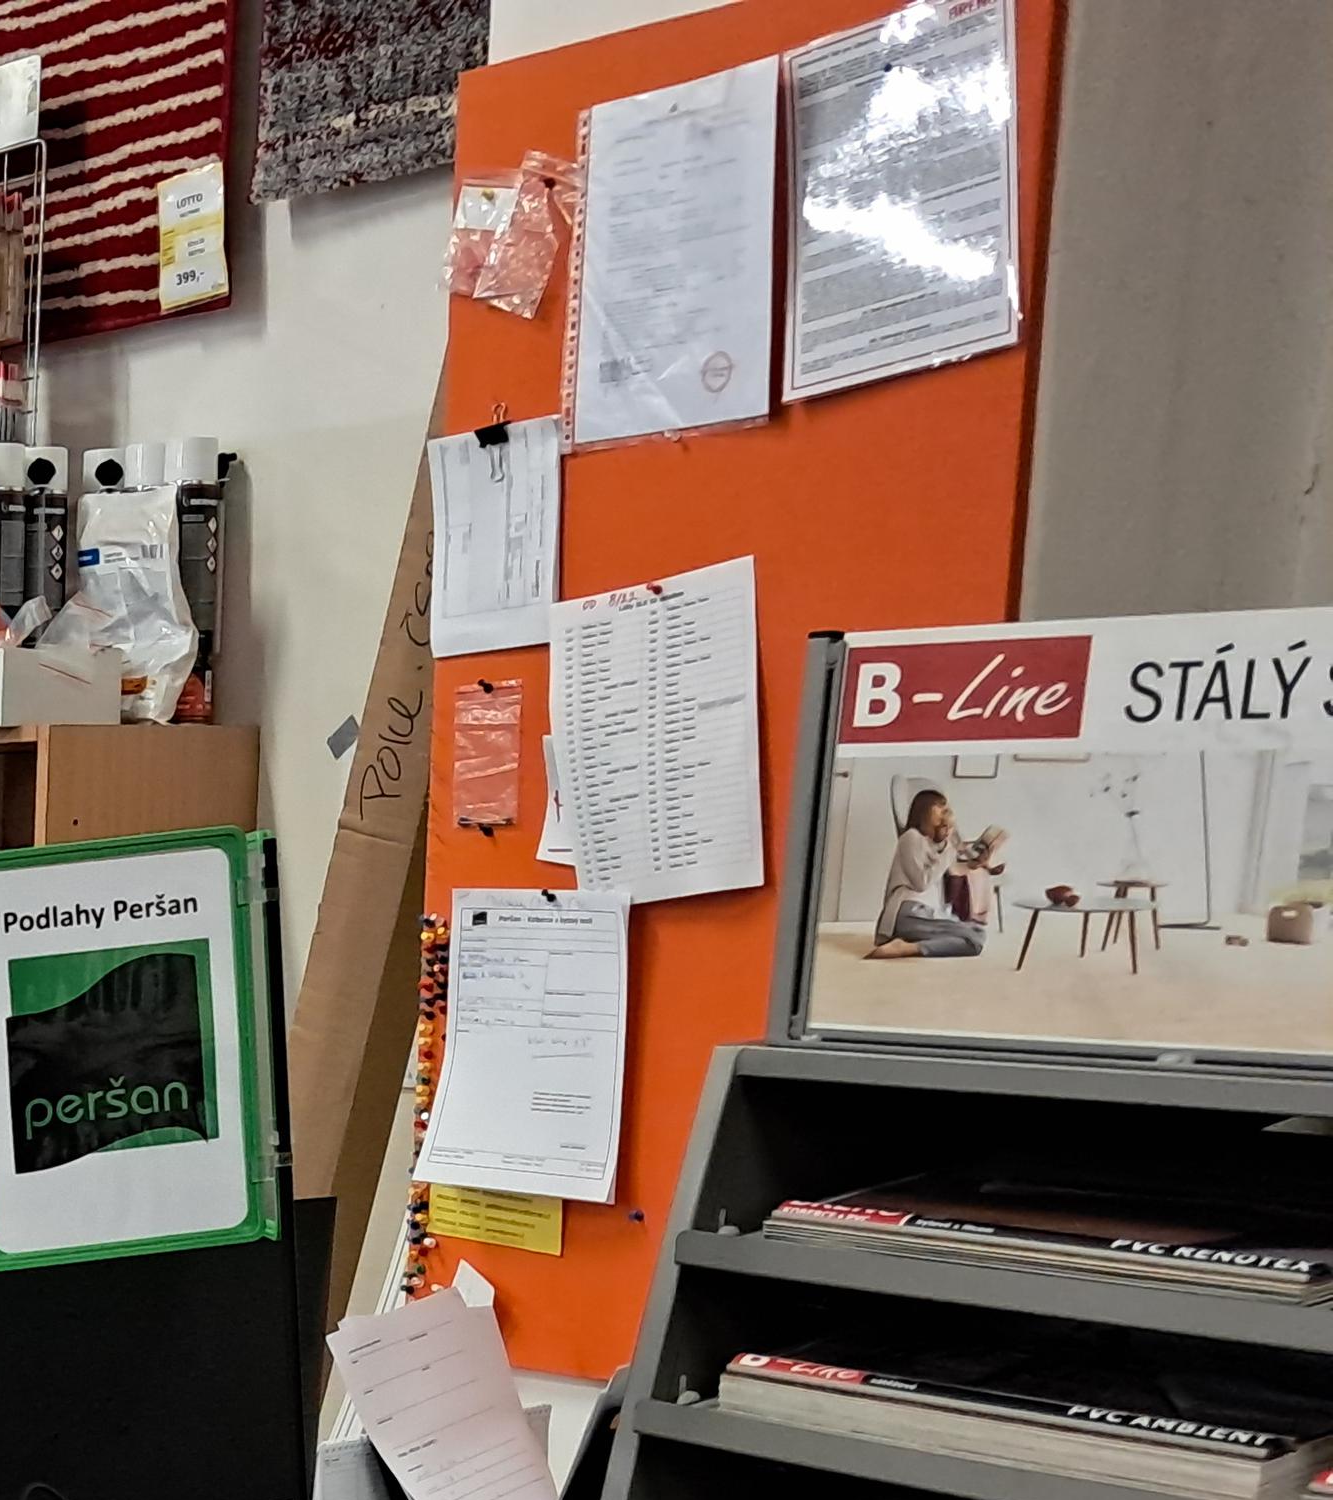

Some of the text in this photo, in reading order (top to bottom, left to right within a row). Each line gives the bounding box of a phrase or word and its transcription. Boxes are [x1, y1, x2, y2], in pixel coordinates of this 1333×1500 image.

[176, 193, 203, 209] LOTTO
[175, 269, 206, 287] 399,-
[851, 652, 1073, 728] B-Line
[1123, 640, 1313, 724] STÁLÝ
[3, 893, 199, 934] Podlahy Peršan
[24, 1075, 190, 1140] peršan
[1110, 1238, 1320, 1274] PVC RENOTEX
[1068, 1403, 1275, 1447] PVC AMBIENT
